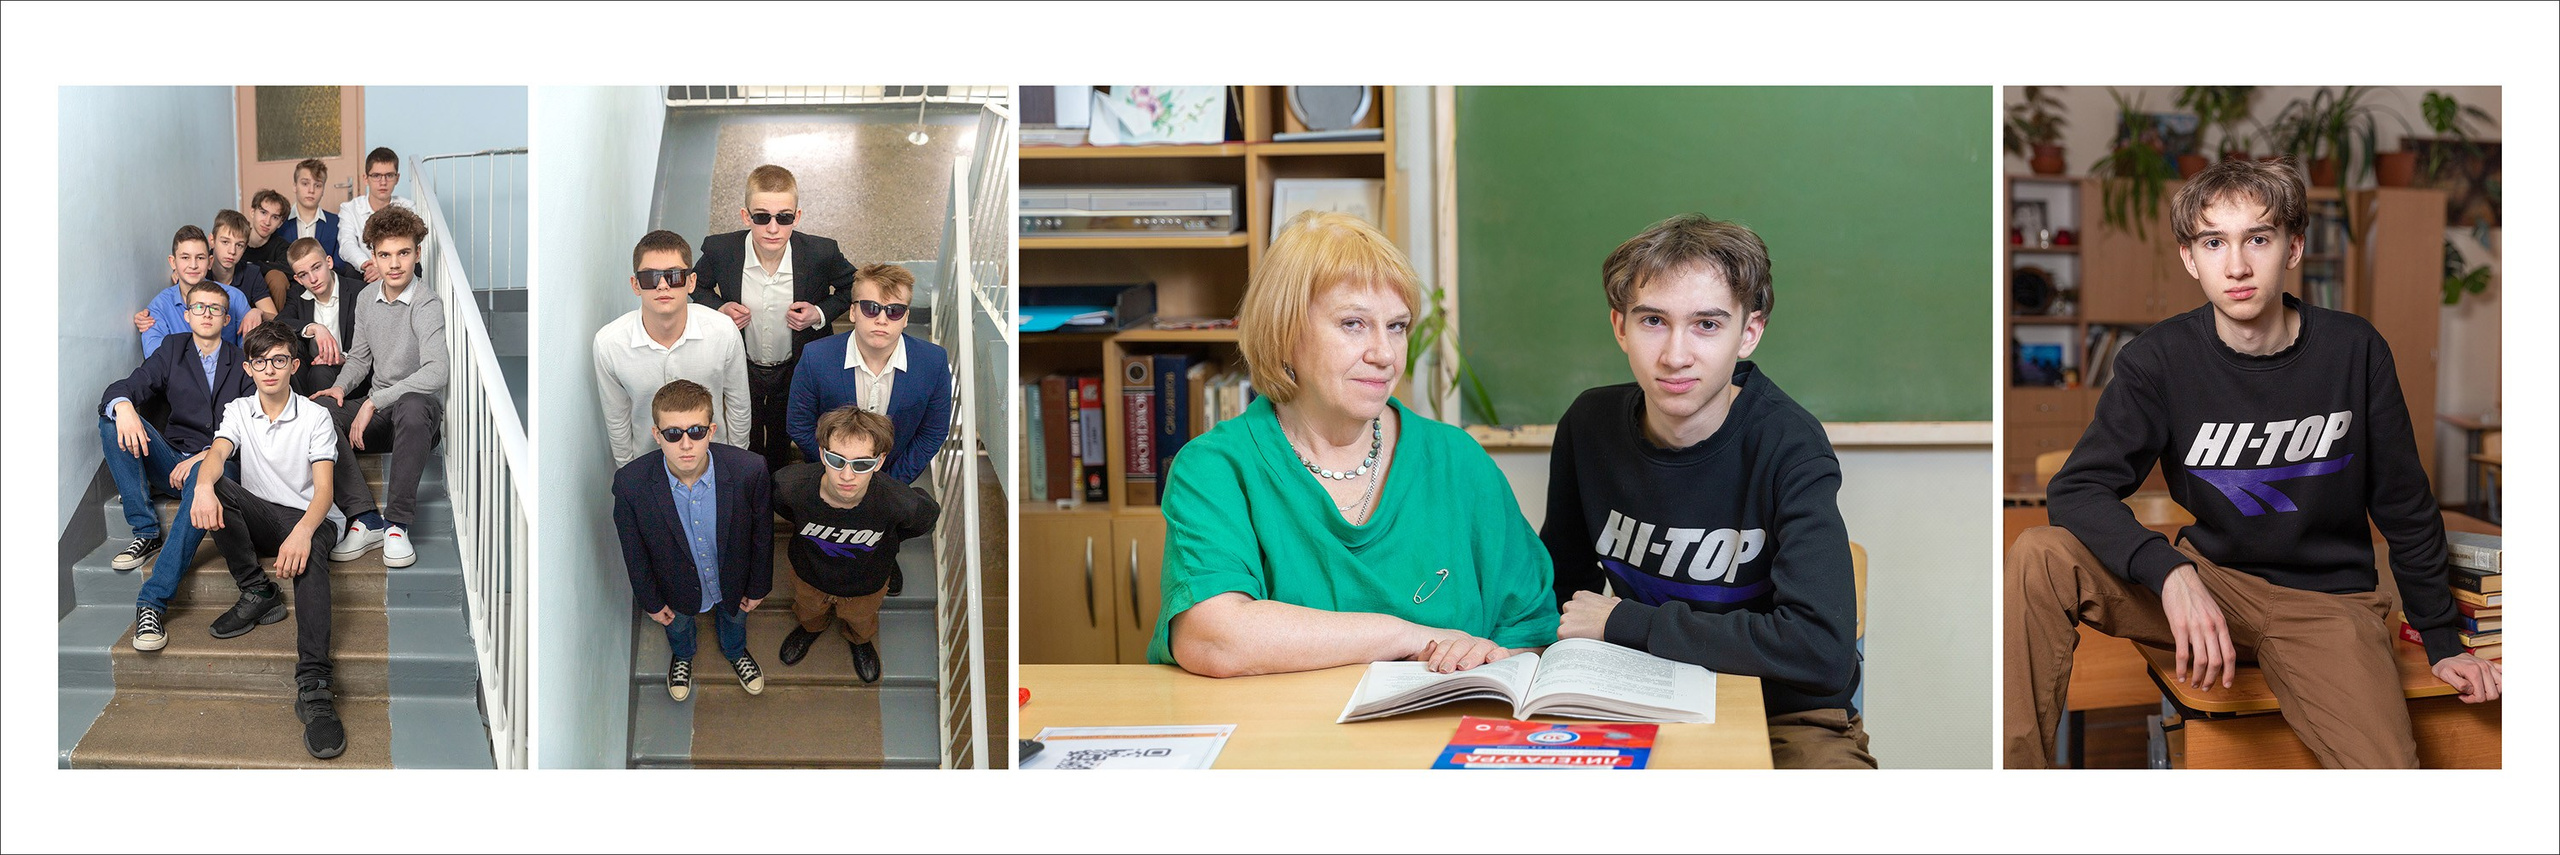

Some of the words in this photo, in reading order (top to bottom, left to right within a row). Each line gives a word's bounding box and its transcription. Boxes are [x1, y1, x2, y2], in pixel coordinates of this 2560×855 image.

[2184, 410, 2353, 467] HI-TOP
[1595, 509, 1767, 584] HI-TOP
[1542, 733, 1565, 742] 30
[1465, 754, 1622, 766] ЛИТЕРАТУРА
